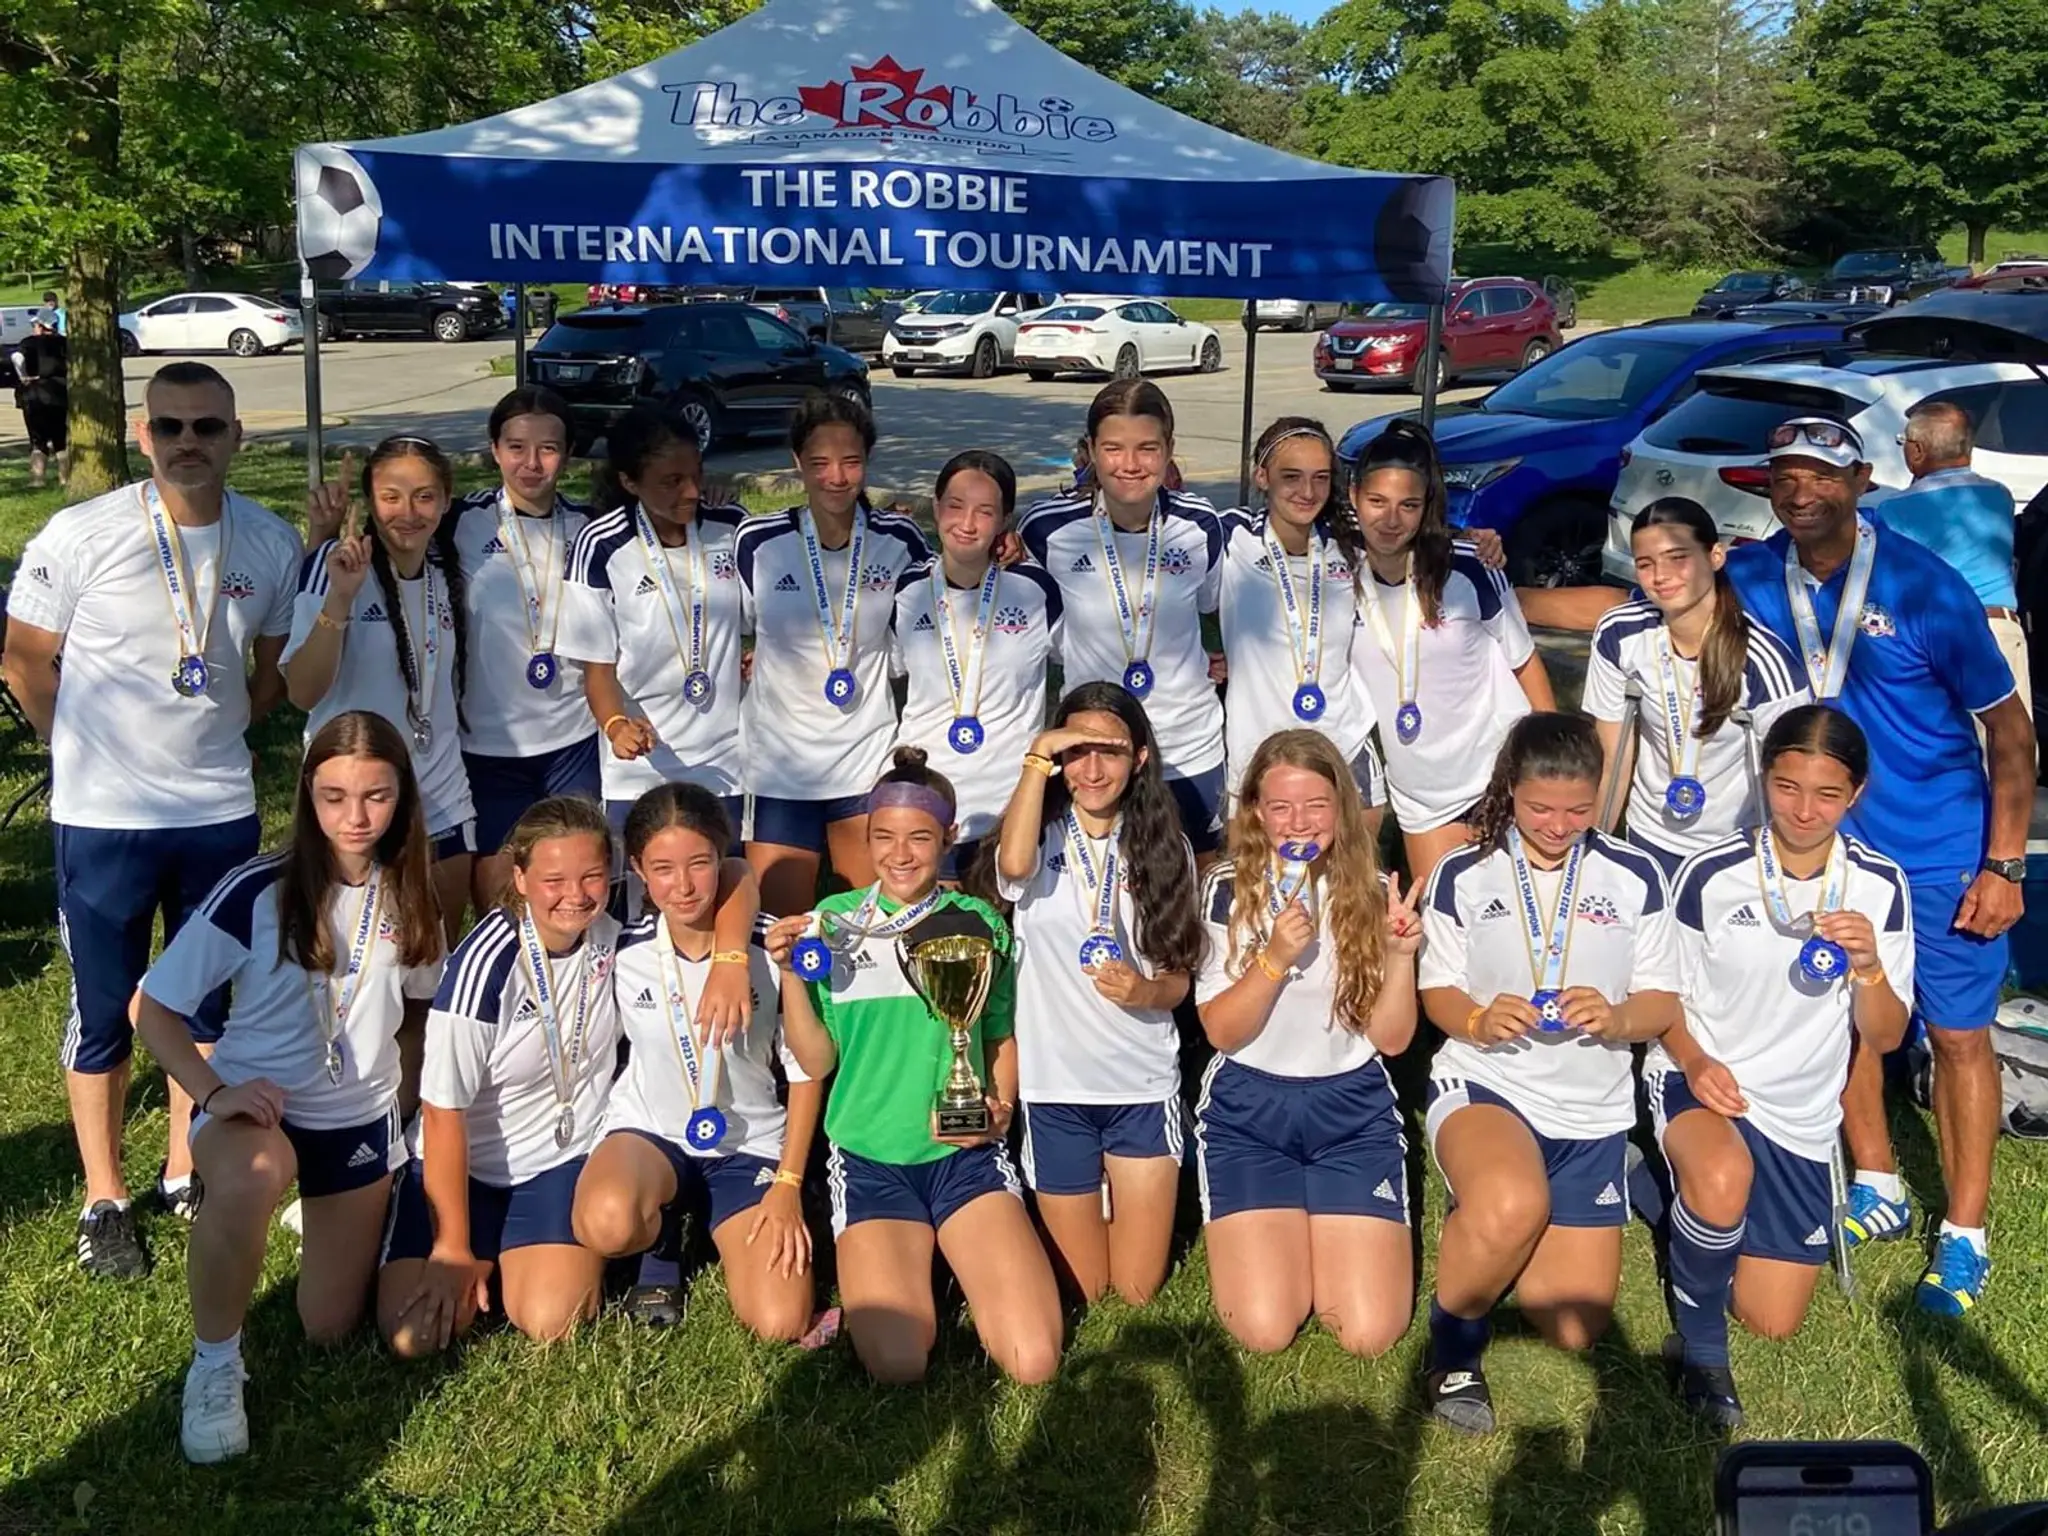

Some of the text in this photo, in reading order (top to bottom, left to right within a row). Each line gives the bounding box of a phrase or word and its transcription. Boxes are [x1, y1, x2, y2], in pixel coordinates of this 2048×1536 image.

[662, 81, 1117, 142] The Robbie
[785, 131, 894, 141] CANADIAN
[900, 131, 1012, 150] TRADITION
[741, 168, 1029, 215] THE ROBBIE
[489, 222, 1274, 280] INTERNATIONAL TOURNAMENT
[153, 513, 174, 571] CHAMPIONS
[849, 536, 862, 587] CHAMPIONS
[806, 536, 829, 609] 2023 CHAMPIONS
[982, 580, 993, 603] 2023
[1104, 545, 1130, 619] 2023 CHAMPIONS
[1269, 542, 1296, 611] 2023 CHAMPIONS
[1310, 563, 1320, 637] 2023 CHAMPIONS
[691, 604, 701, 656] CHAMPIONS
[943, 635, 962, 696] 2023 CHAMP
[1666, 691, 1678, 713] 2023
[1073, 834, 1097, 889] CHAMPIONS
[1101, 854, 1114, 904] CHAMPIONS
[1558, 843, 1580, 919] 2023 CHAMPIONS
[1480, 908, 1511, 920] adidas
[1516, 858, 1541, 938] 2023 CHAMPIONS
[1728, 917, 1761, 927] adidas
[349, 884, 377, 975] 2023 CHAMPIONS
[529, 942, 549, 1003] CHAMPIONS
[575, 975, 588, 1037] CHAMPIONS
[679, 1035, 694, 1060] 2023
[1444, 1371, 1474, 1386] NIKE
